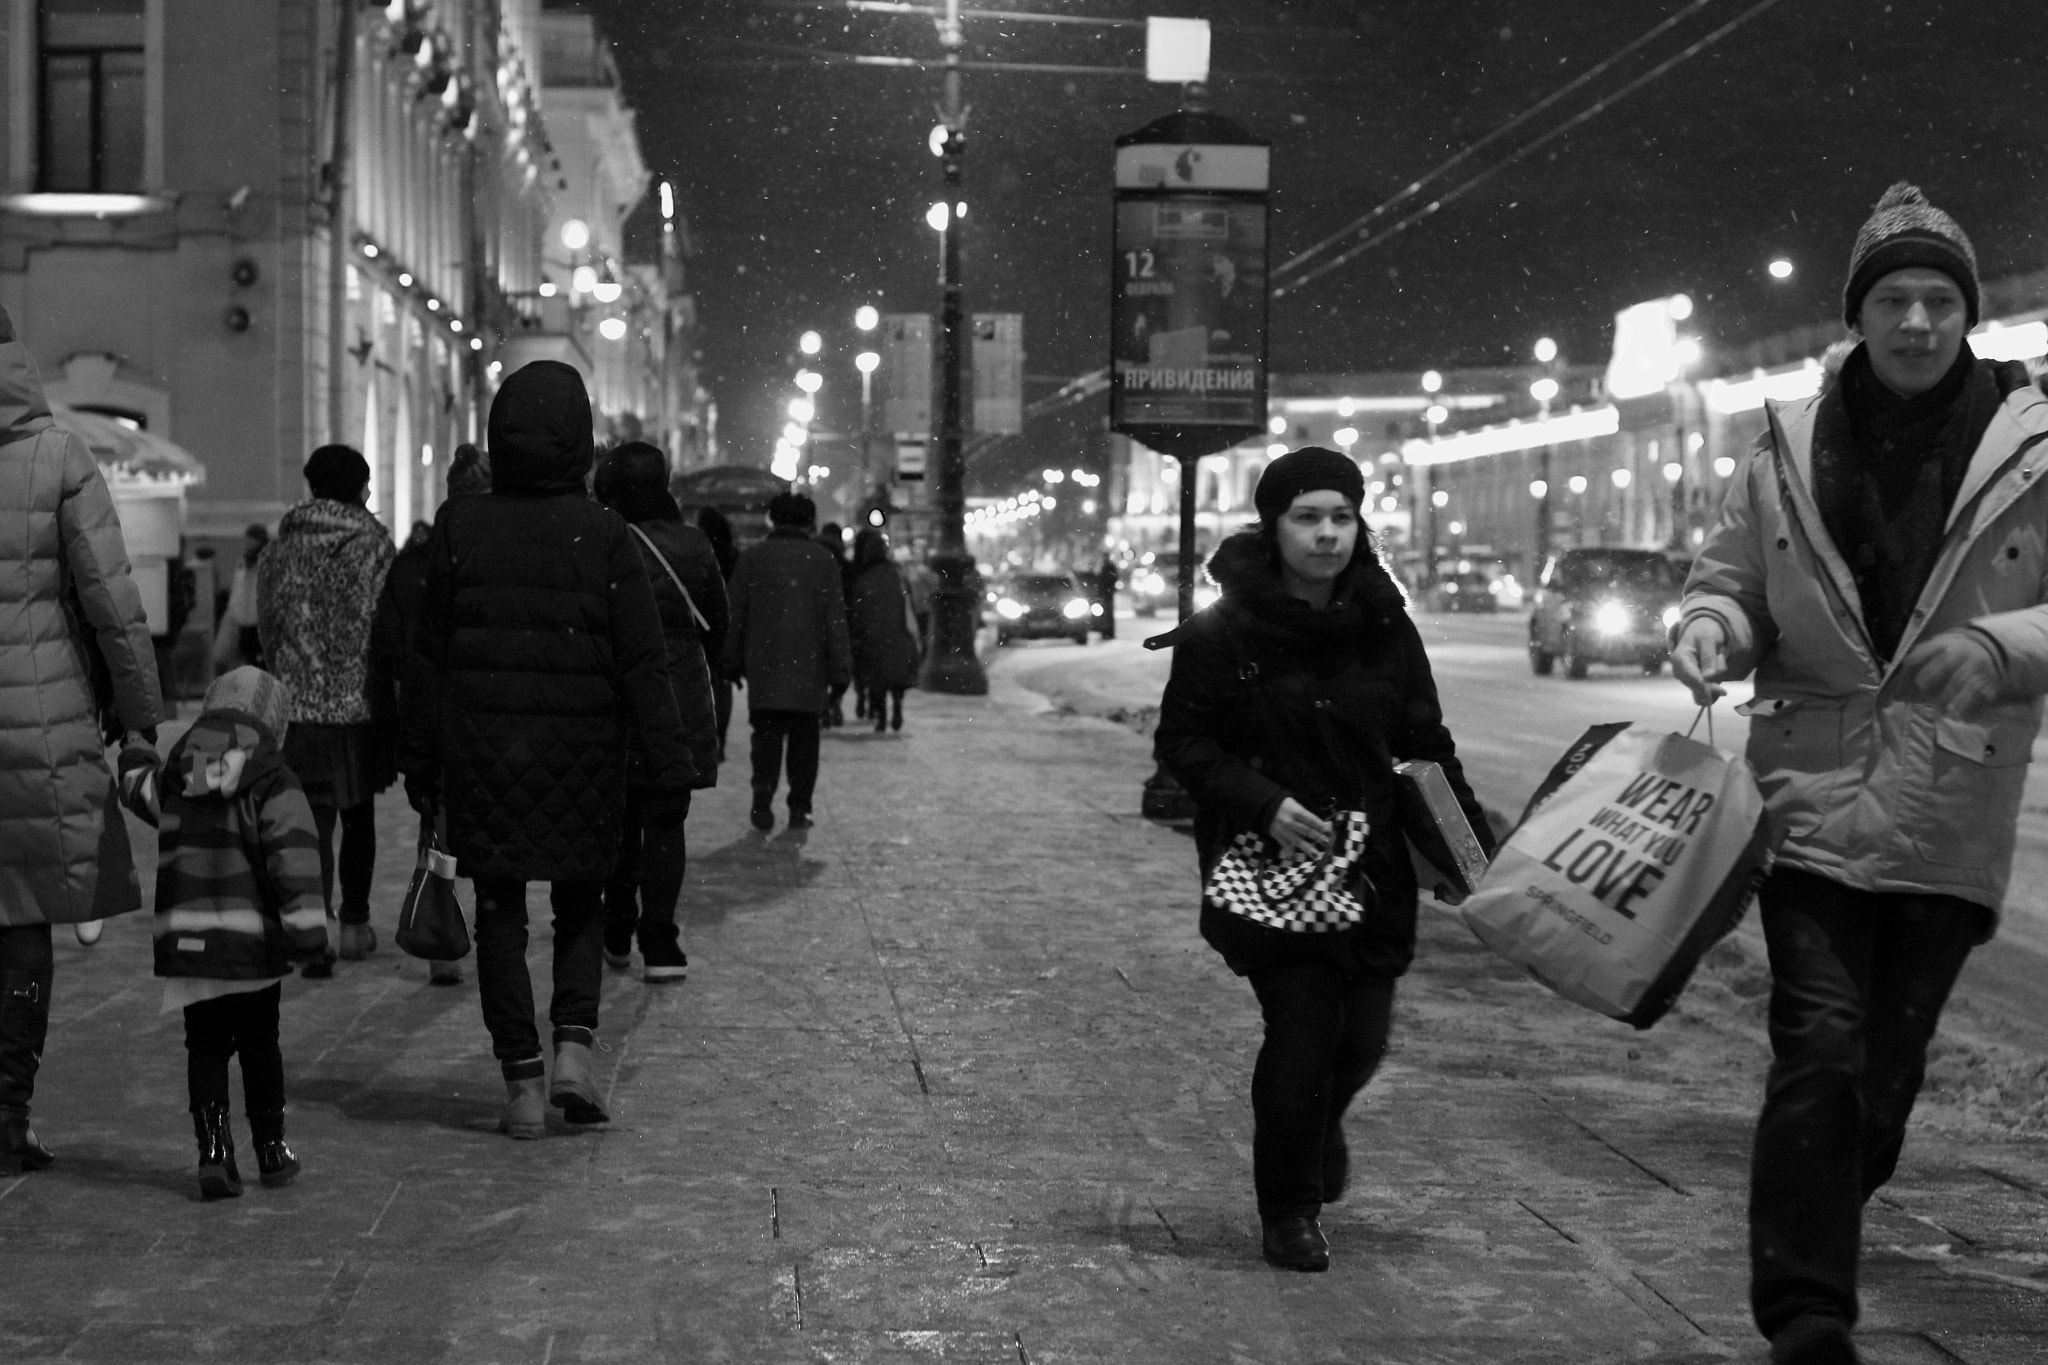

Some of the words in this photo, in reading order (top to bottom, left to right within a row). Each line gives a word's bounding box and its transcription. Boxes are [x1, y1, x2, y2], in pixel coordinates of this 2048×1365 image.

[1124, 251, 1155, 278] 12
[1124, 368, 1255, 393] ПРИВИДЕНИЯ
[1614, 771, 1714, 836] WEAR
[1589, 806, 1651, 845] WHAT
[1642, 831, 1687, 866] YOU
[1542, 828, 1665, 921] LOVE
